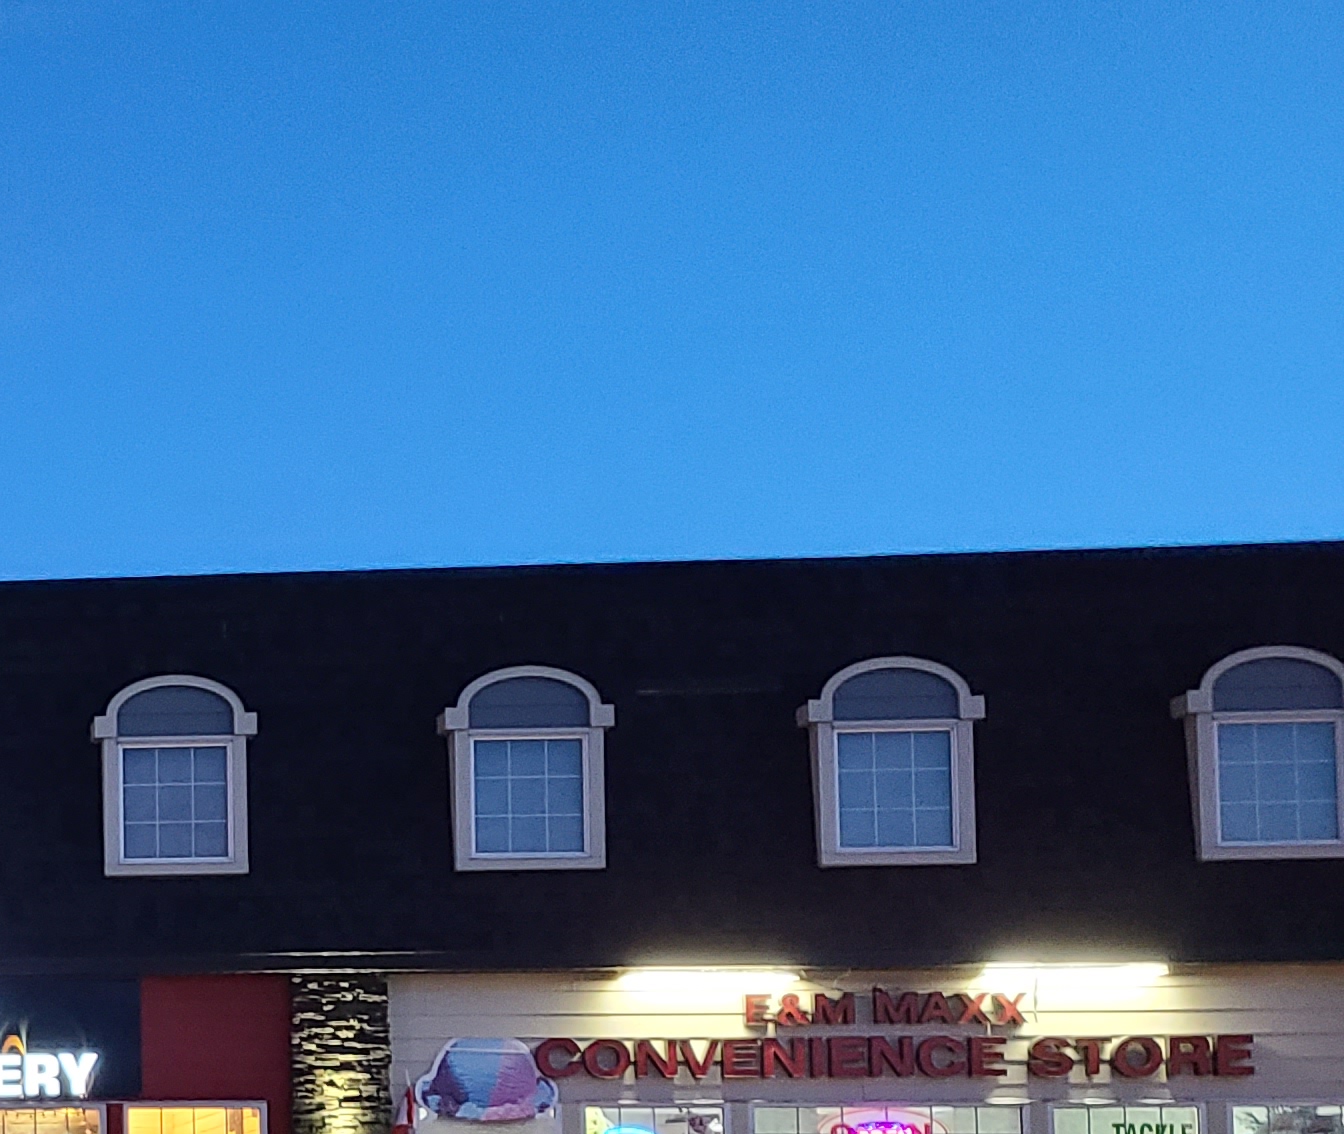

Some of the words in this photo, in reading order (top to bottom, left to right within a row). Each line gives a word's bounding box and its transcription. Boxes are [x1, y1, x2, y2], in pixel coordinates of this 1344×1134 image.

[744, 992, 857, 1026] E&M
[872, 988, 1026, 1026] MAXX
[535, 1036, 1008, 1079] CONVENIENCE
[1028, 1034, 1255, 1079] STORE
